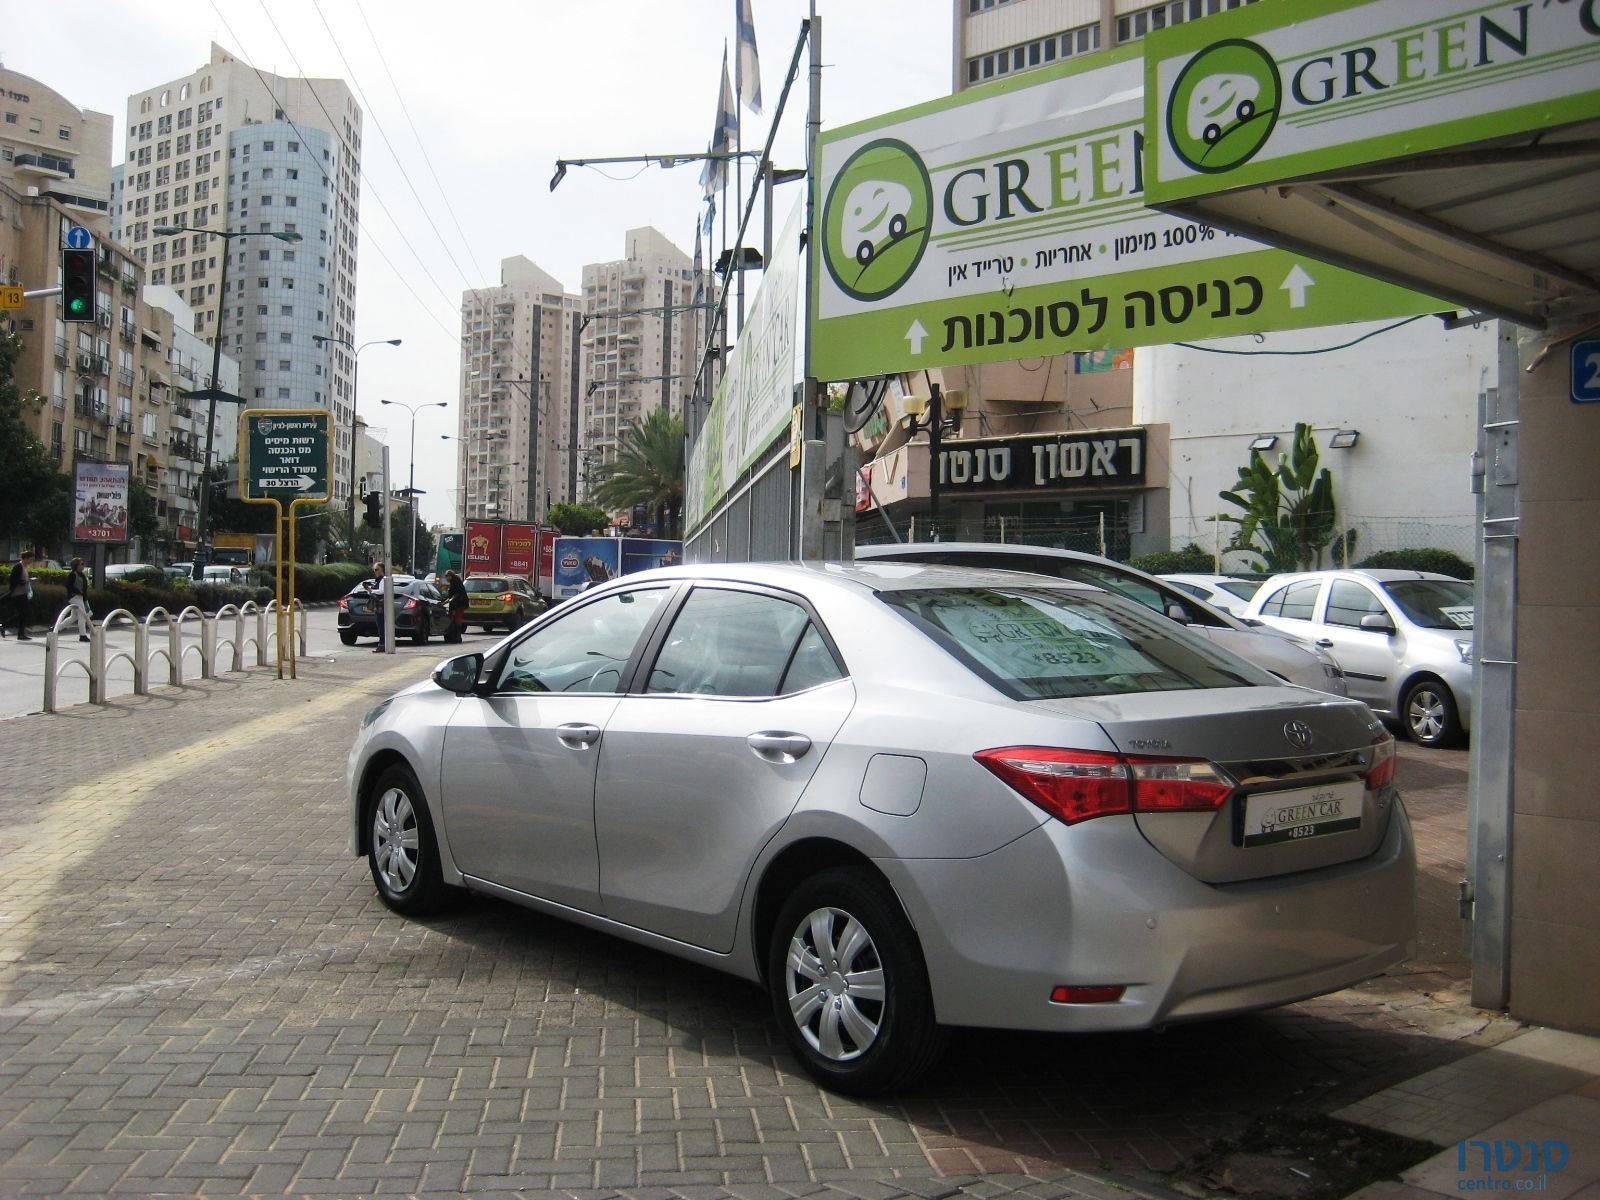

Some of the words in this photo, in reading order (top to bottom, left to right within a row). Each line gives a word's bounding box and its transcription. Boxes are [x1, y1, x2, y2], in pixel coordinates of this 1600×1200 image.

[1292, 4, 1533, 106] GREEN
[943, 130, 1144, 226] GREE
[1114, 231, 1156, 261] מימון
[1163, 223, 1215, 249] 100%
[971, 256, 1014, 278] טרייד
[1035, 243, 1092, 269] אחריות
[948, 263, 968, 287] אין
[8, 292, 20, 304] 13
[1124, 275, 1263, 330] כניסה
[941, 288, 1108, 352] לסוכנות
[264, 437, 290, 445] מיסים
[298, 446, 312, 454] מס
[262, 466, 290, 474] הרישוי
[279, 456, 300, 464] דואר
[1032, 438, 1141, 486] ראשון
[279, 478, 299, 486] הרצל
[1278, 803, 1316, 823] GREEN
[1320, 801, 1342, 816] CAR
